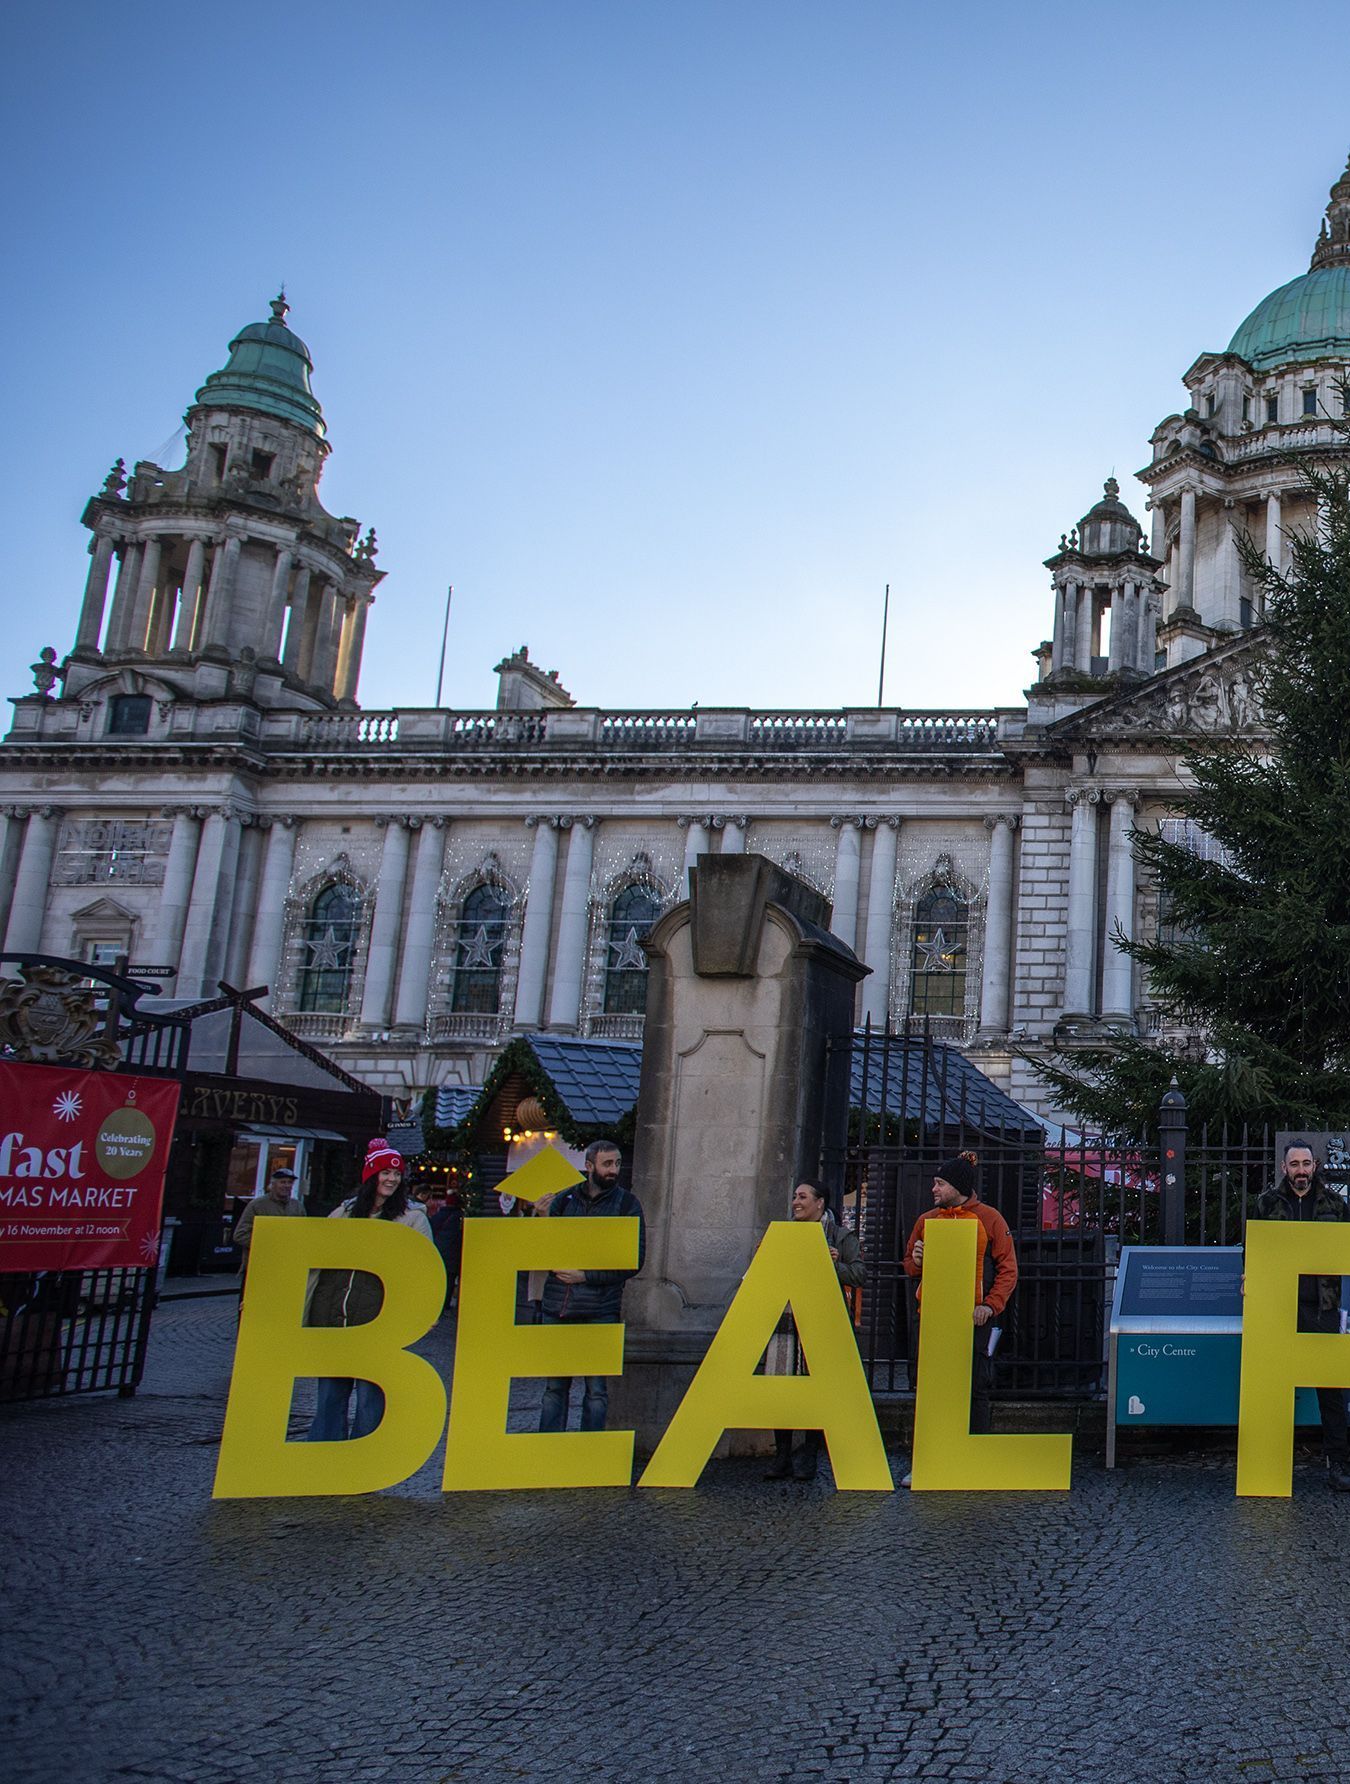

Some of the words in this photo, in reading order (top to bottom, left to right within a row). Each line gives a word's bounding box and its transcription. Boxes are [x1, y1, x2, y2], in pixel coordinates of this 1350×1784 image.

[128, 967, 146, 975] FOOD
[147, 967, 171, 975] COURT
[180, 1086, 299, 1125] AVERYS
[100, 1132, 153, 1147] Celebrating
[0, 1132, 89, 1180] fast
[105, 1146, 118, 1156] 20
[120, 1146, 144, 1157] Years
[0, 1186, 44, 1207] MAS
[49, 1187, 138, 1208] MARKET
[7, 1224, 18, 1235] 16
[21, 1224, 73, 1235] November
[75, 1226, 84, 1235] at
[86, 1224, 95, 1234] 12
[96, 1225, 120, 1234] noon
[1137, 1343, 1160, 1358] City
[1162, 1343, 1197, 1357] Centre
